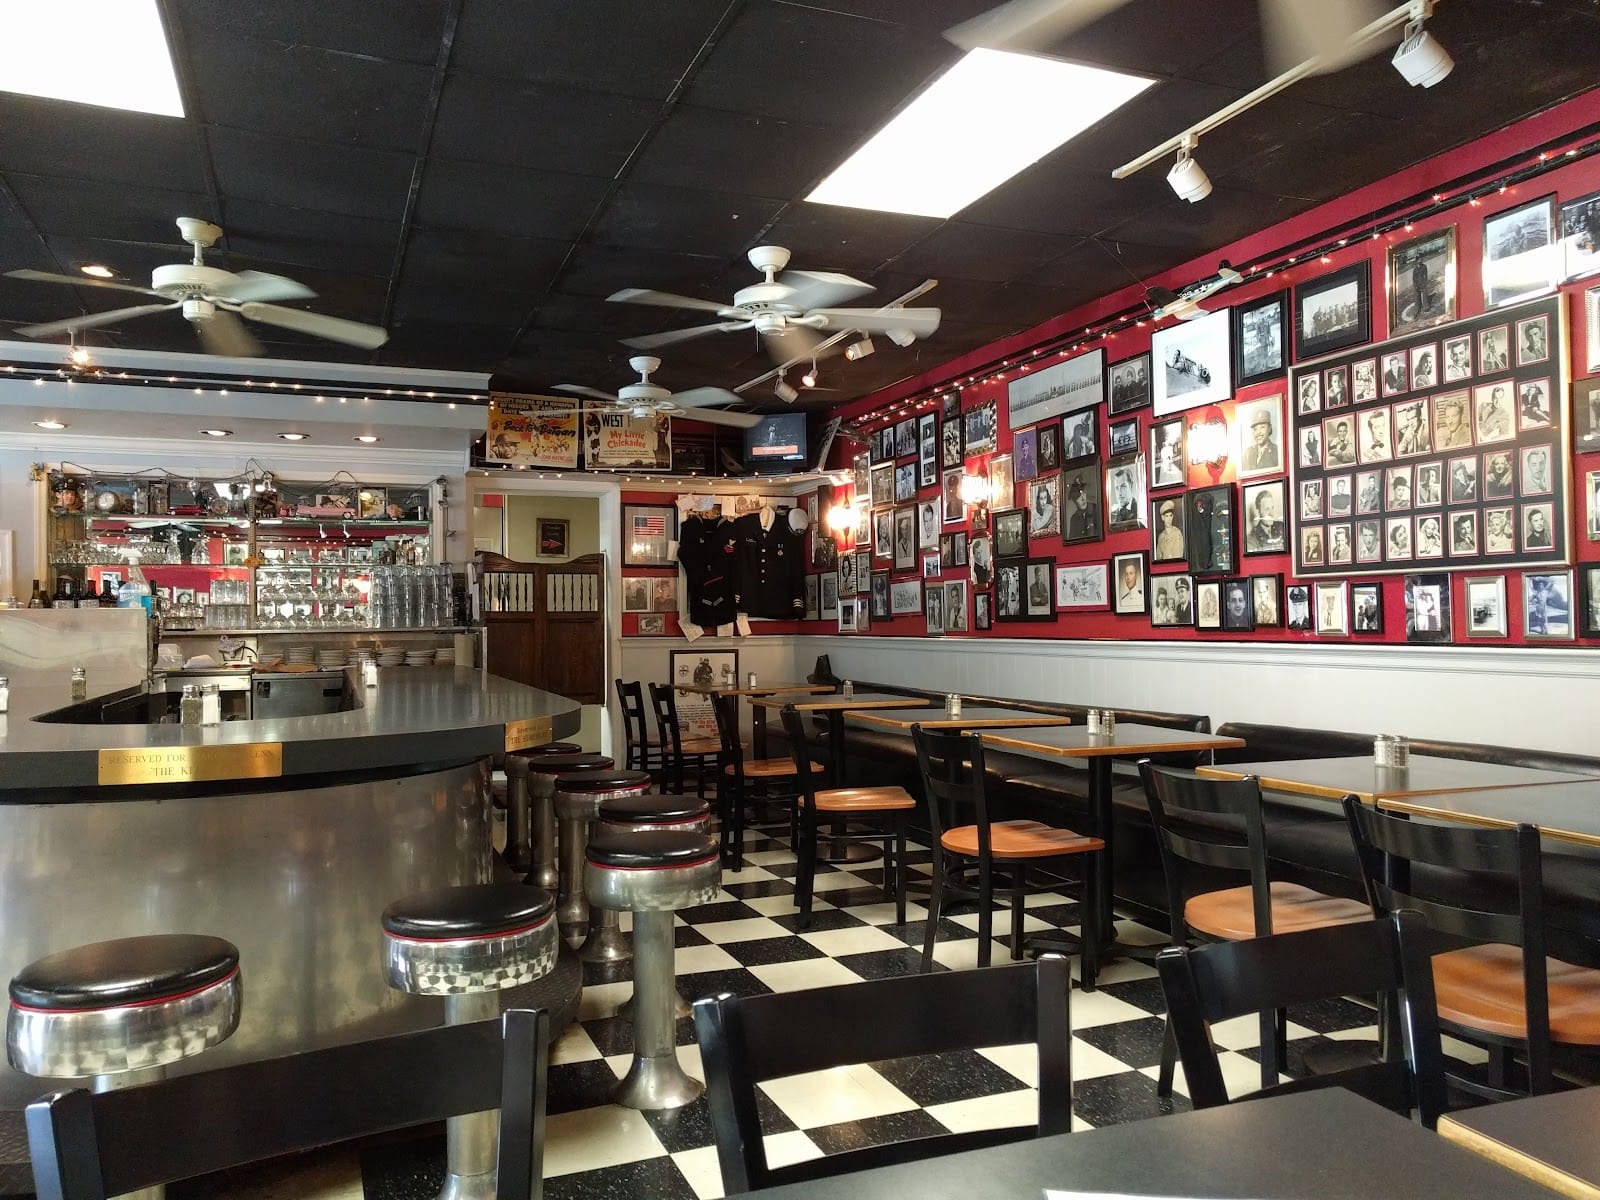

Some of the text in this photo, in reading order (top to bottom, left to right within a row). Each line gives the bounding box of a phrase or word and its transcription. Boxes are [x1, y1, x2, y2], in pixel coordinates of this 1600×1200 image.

[503, 420, 524, 432] Back
[601, 414, 624, 427] WEST
[610, 429, 645, 440] My Little
[607, 439, 646, 448] Chickadee
[166, 753, 186, 762] FOR
